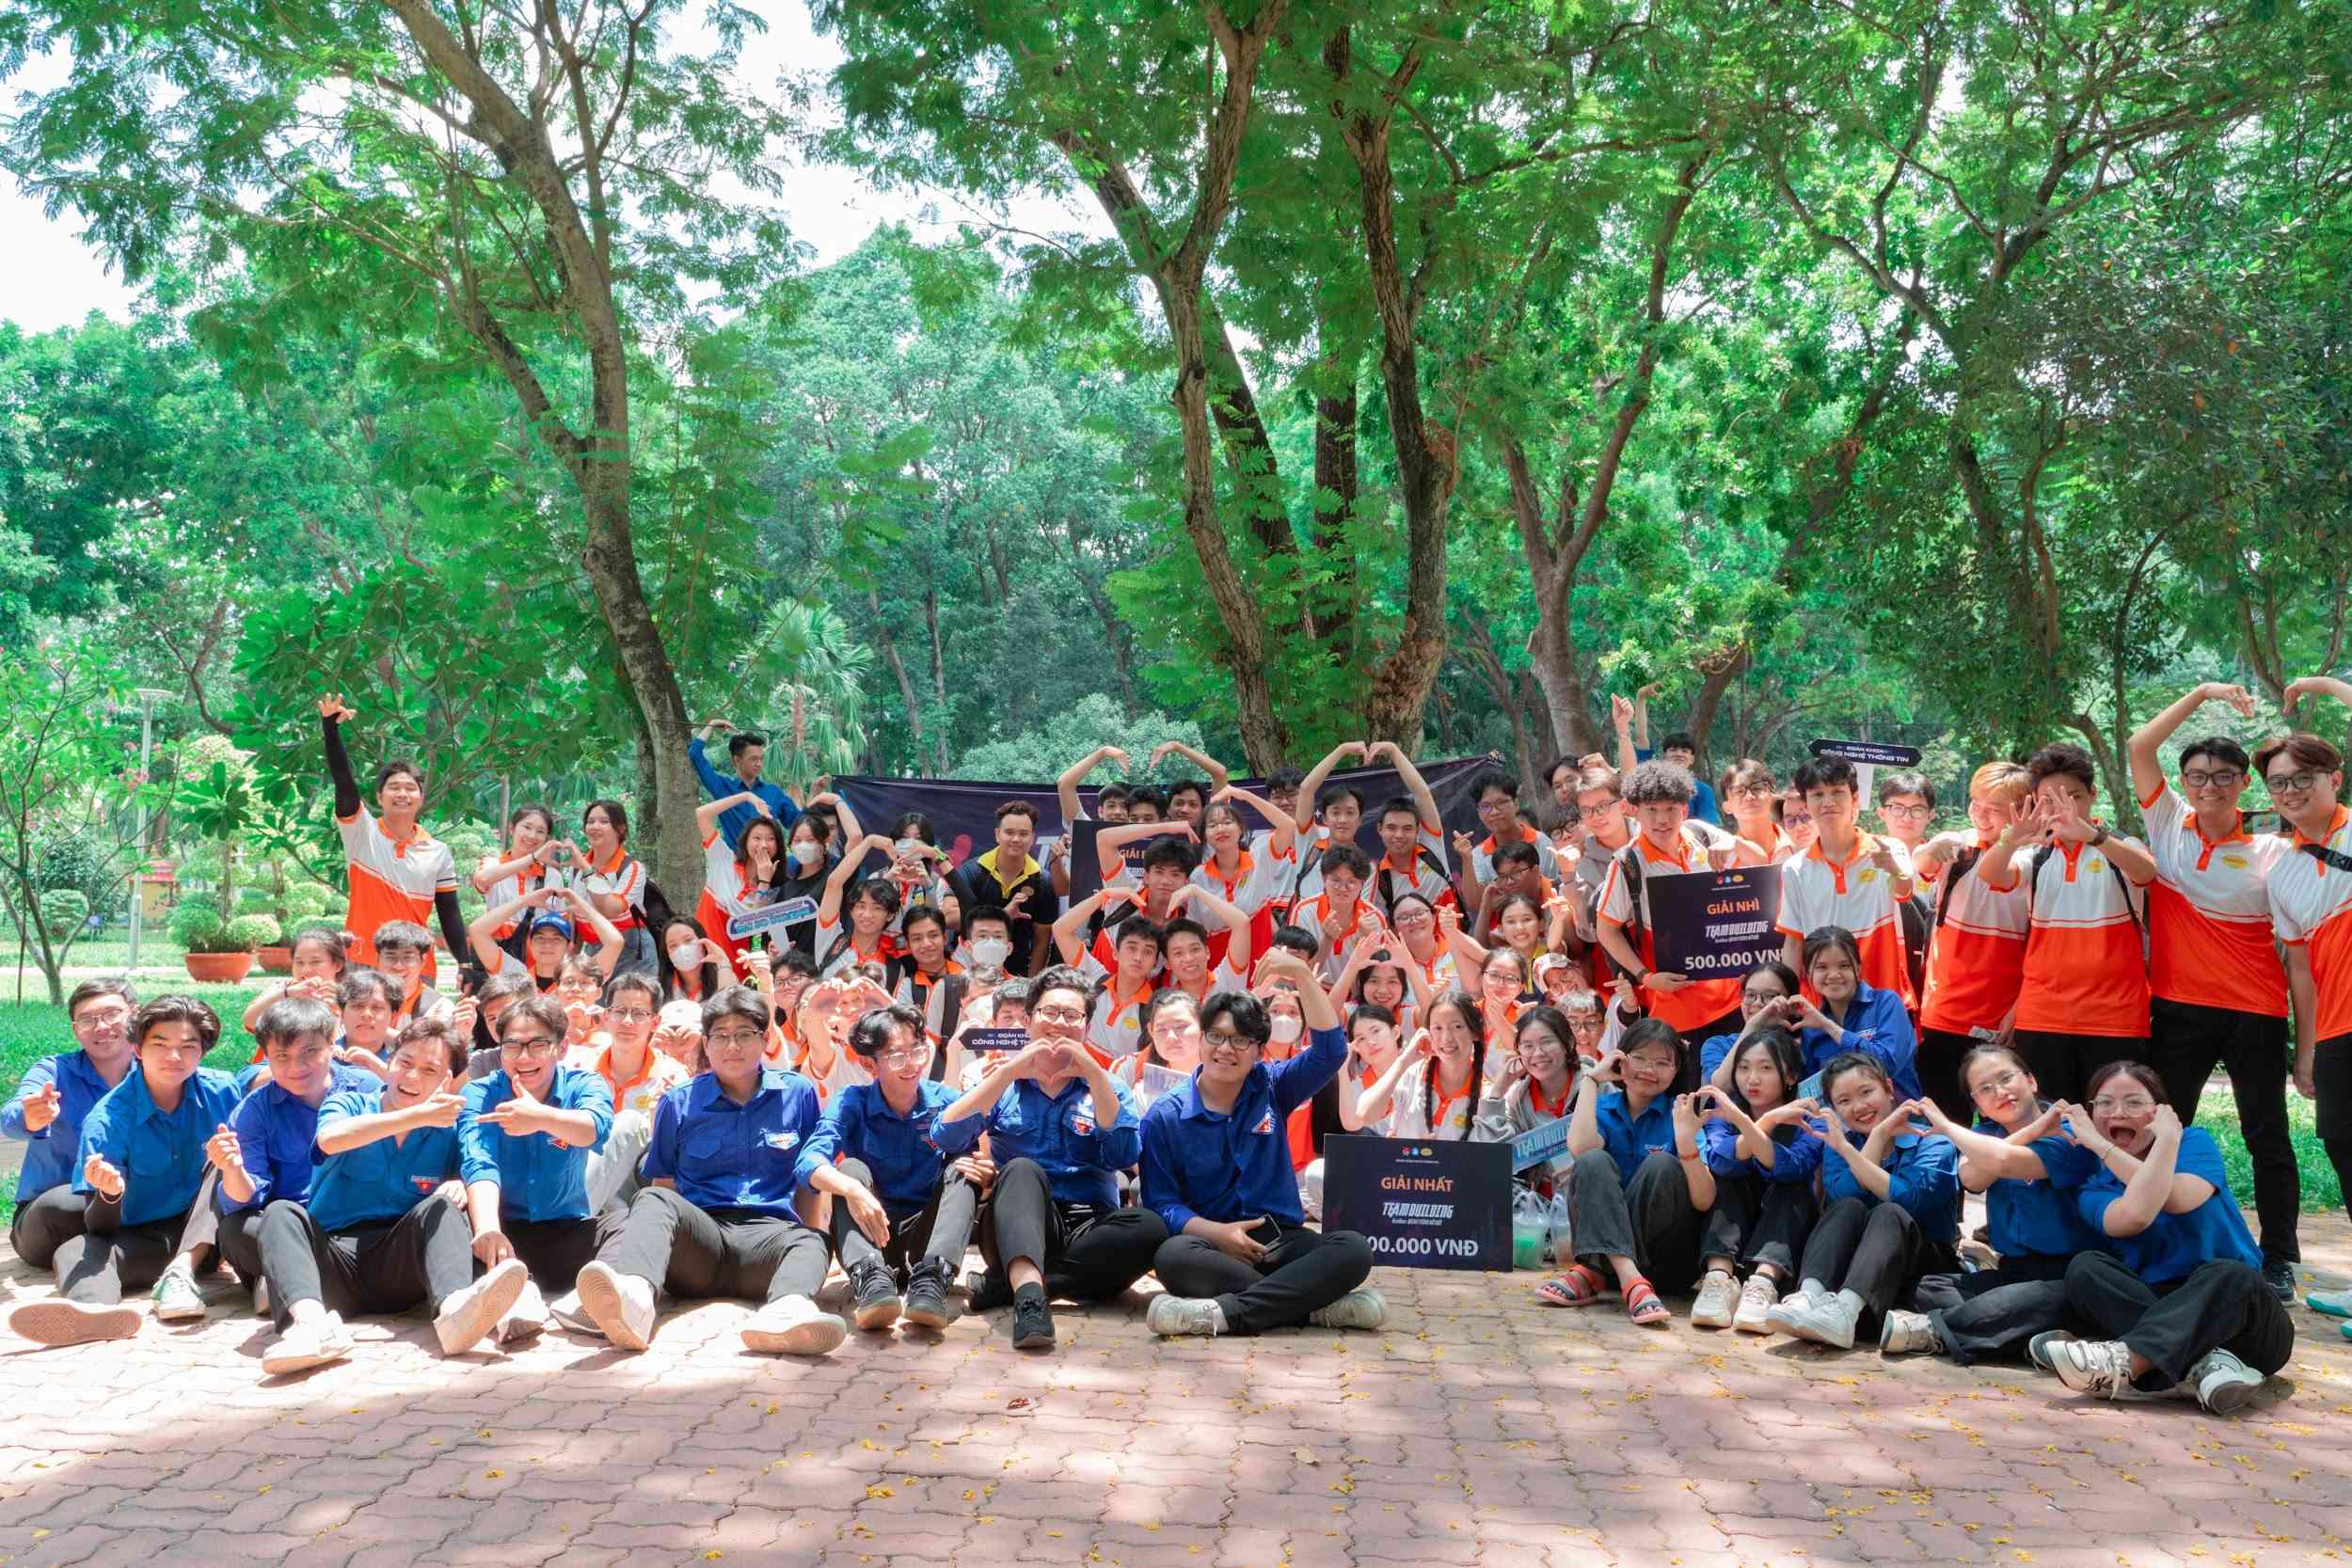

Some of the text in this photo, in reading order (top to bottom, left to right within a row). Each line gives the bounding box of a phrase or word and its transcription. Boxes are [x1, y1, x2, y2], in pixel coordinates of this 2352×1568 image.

[1707, 897, 1759, 915] GIẢI NHÌ
[1685, 951, 1752, 971] 500.000
[1380, 1175, 1453, 1192] GIẢI NHẤT
[1382, 1202, 1454, 1219] TEAMBUILDING
[1363, 1236, 1479, 1257] 00.000 VNĐ
